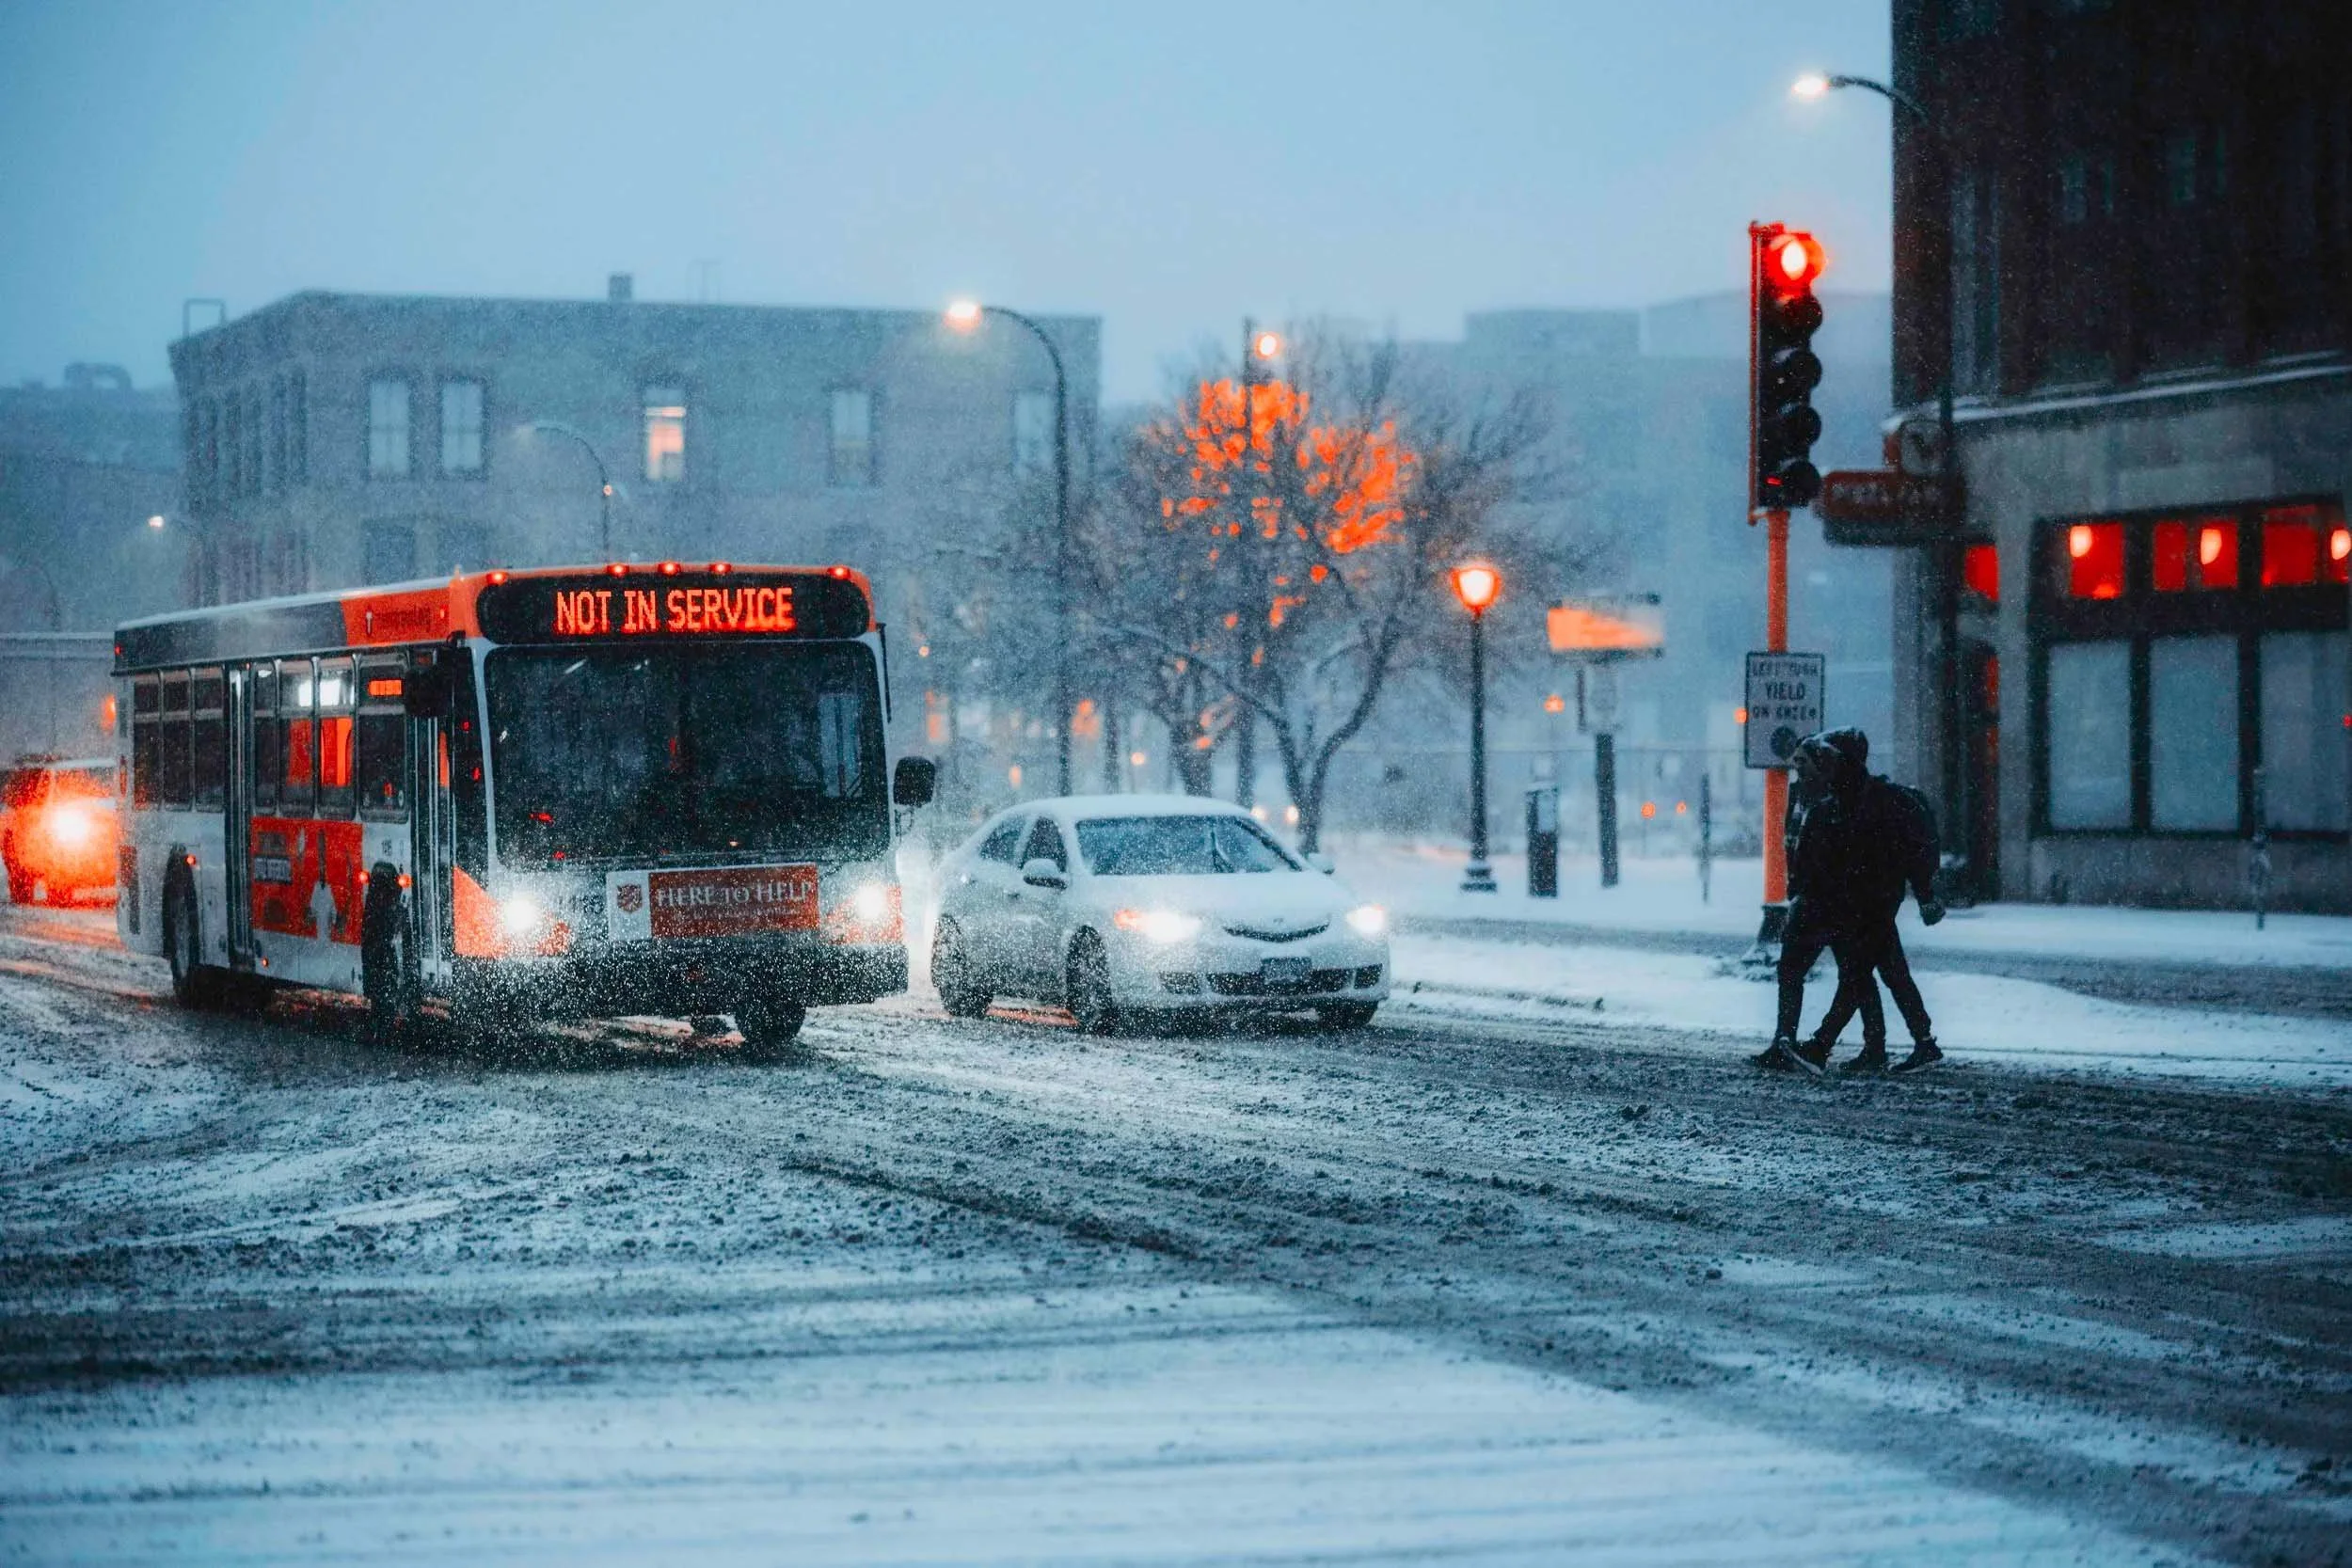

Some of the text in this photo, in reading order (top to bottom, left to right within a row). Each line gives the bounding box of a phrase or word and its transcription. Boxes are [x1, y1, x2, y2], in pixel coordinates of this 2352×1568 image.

[555, 587, 797, 635] NOT IN SERVICE
[1764, 681, 1806, 701] YIELD
[658, 879, 812, 907] HERE TO HELP
